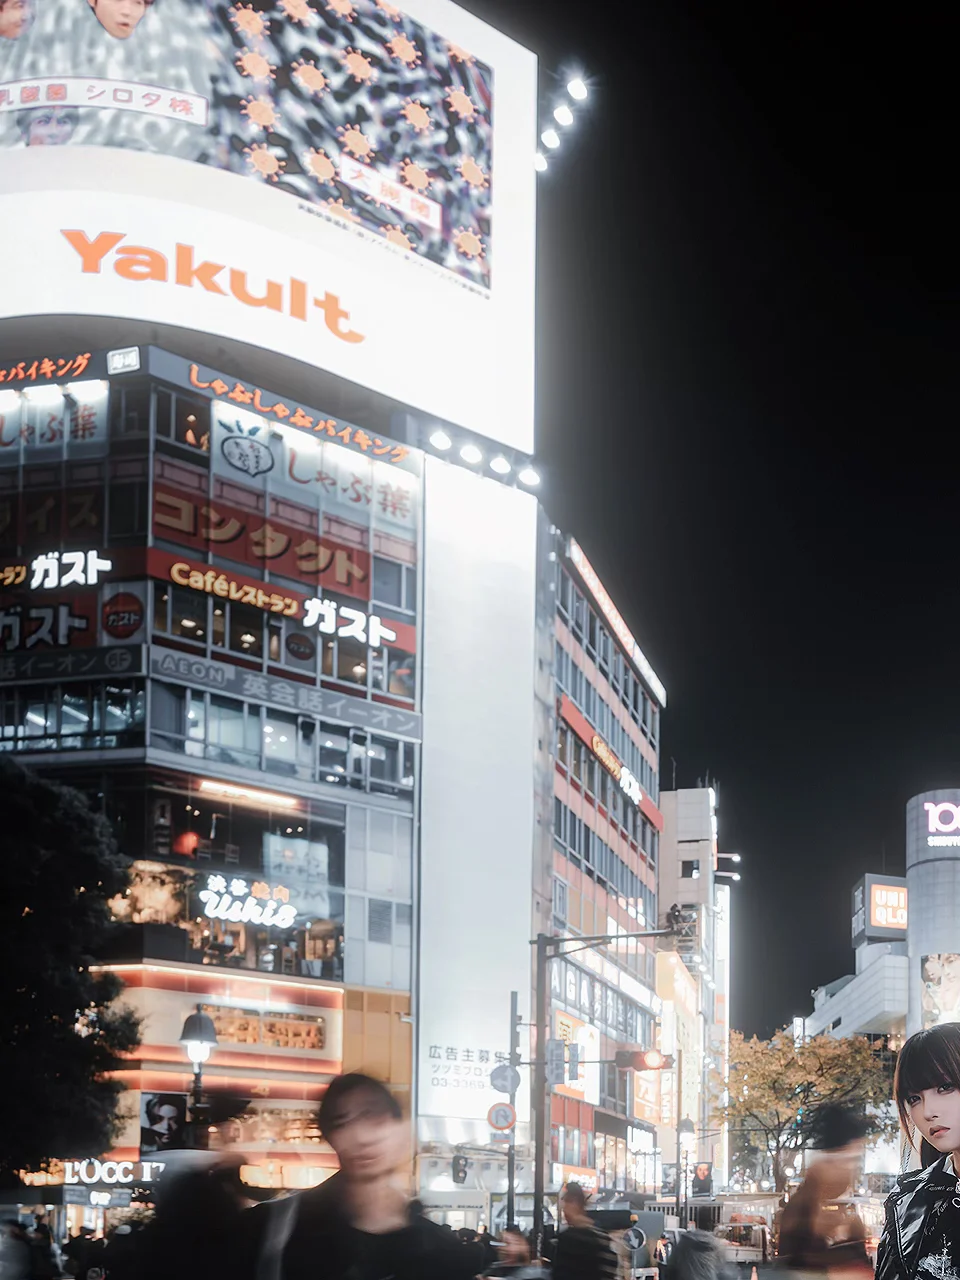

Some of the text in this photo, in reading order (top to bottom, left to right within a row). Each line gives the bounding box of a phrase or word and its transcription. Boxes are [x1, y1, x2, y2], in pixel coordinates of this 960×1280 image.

[60, 229, 366, 344] Yakult
[0, 352, 91, 382] バイキング
[189, 363, 410, 463] しゃぶしゃぶバイキング
[288, 448, 411, 519] しゃぶ葉
[154, 491, 368, 587] コンタクト
[31, 550, 112, 590] ガスト
[108, 612, 140, 626] ガスト
[303, 597, 397, 648] ガスト
[160, 655, 416, 731] AEON 英会話イーオン
[875, 889, 905, 908] UNI
